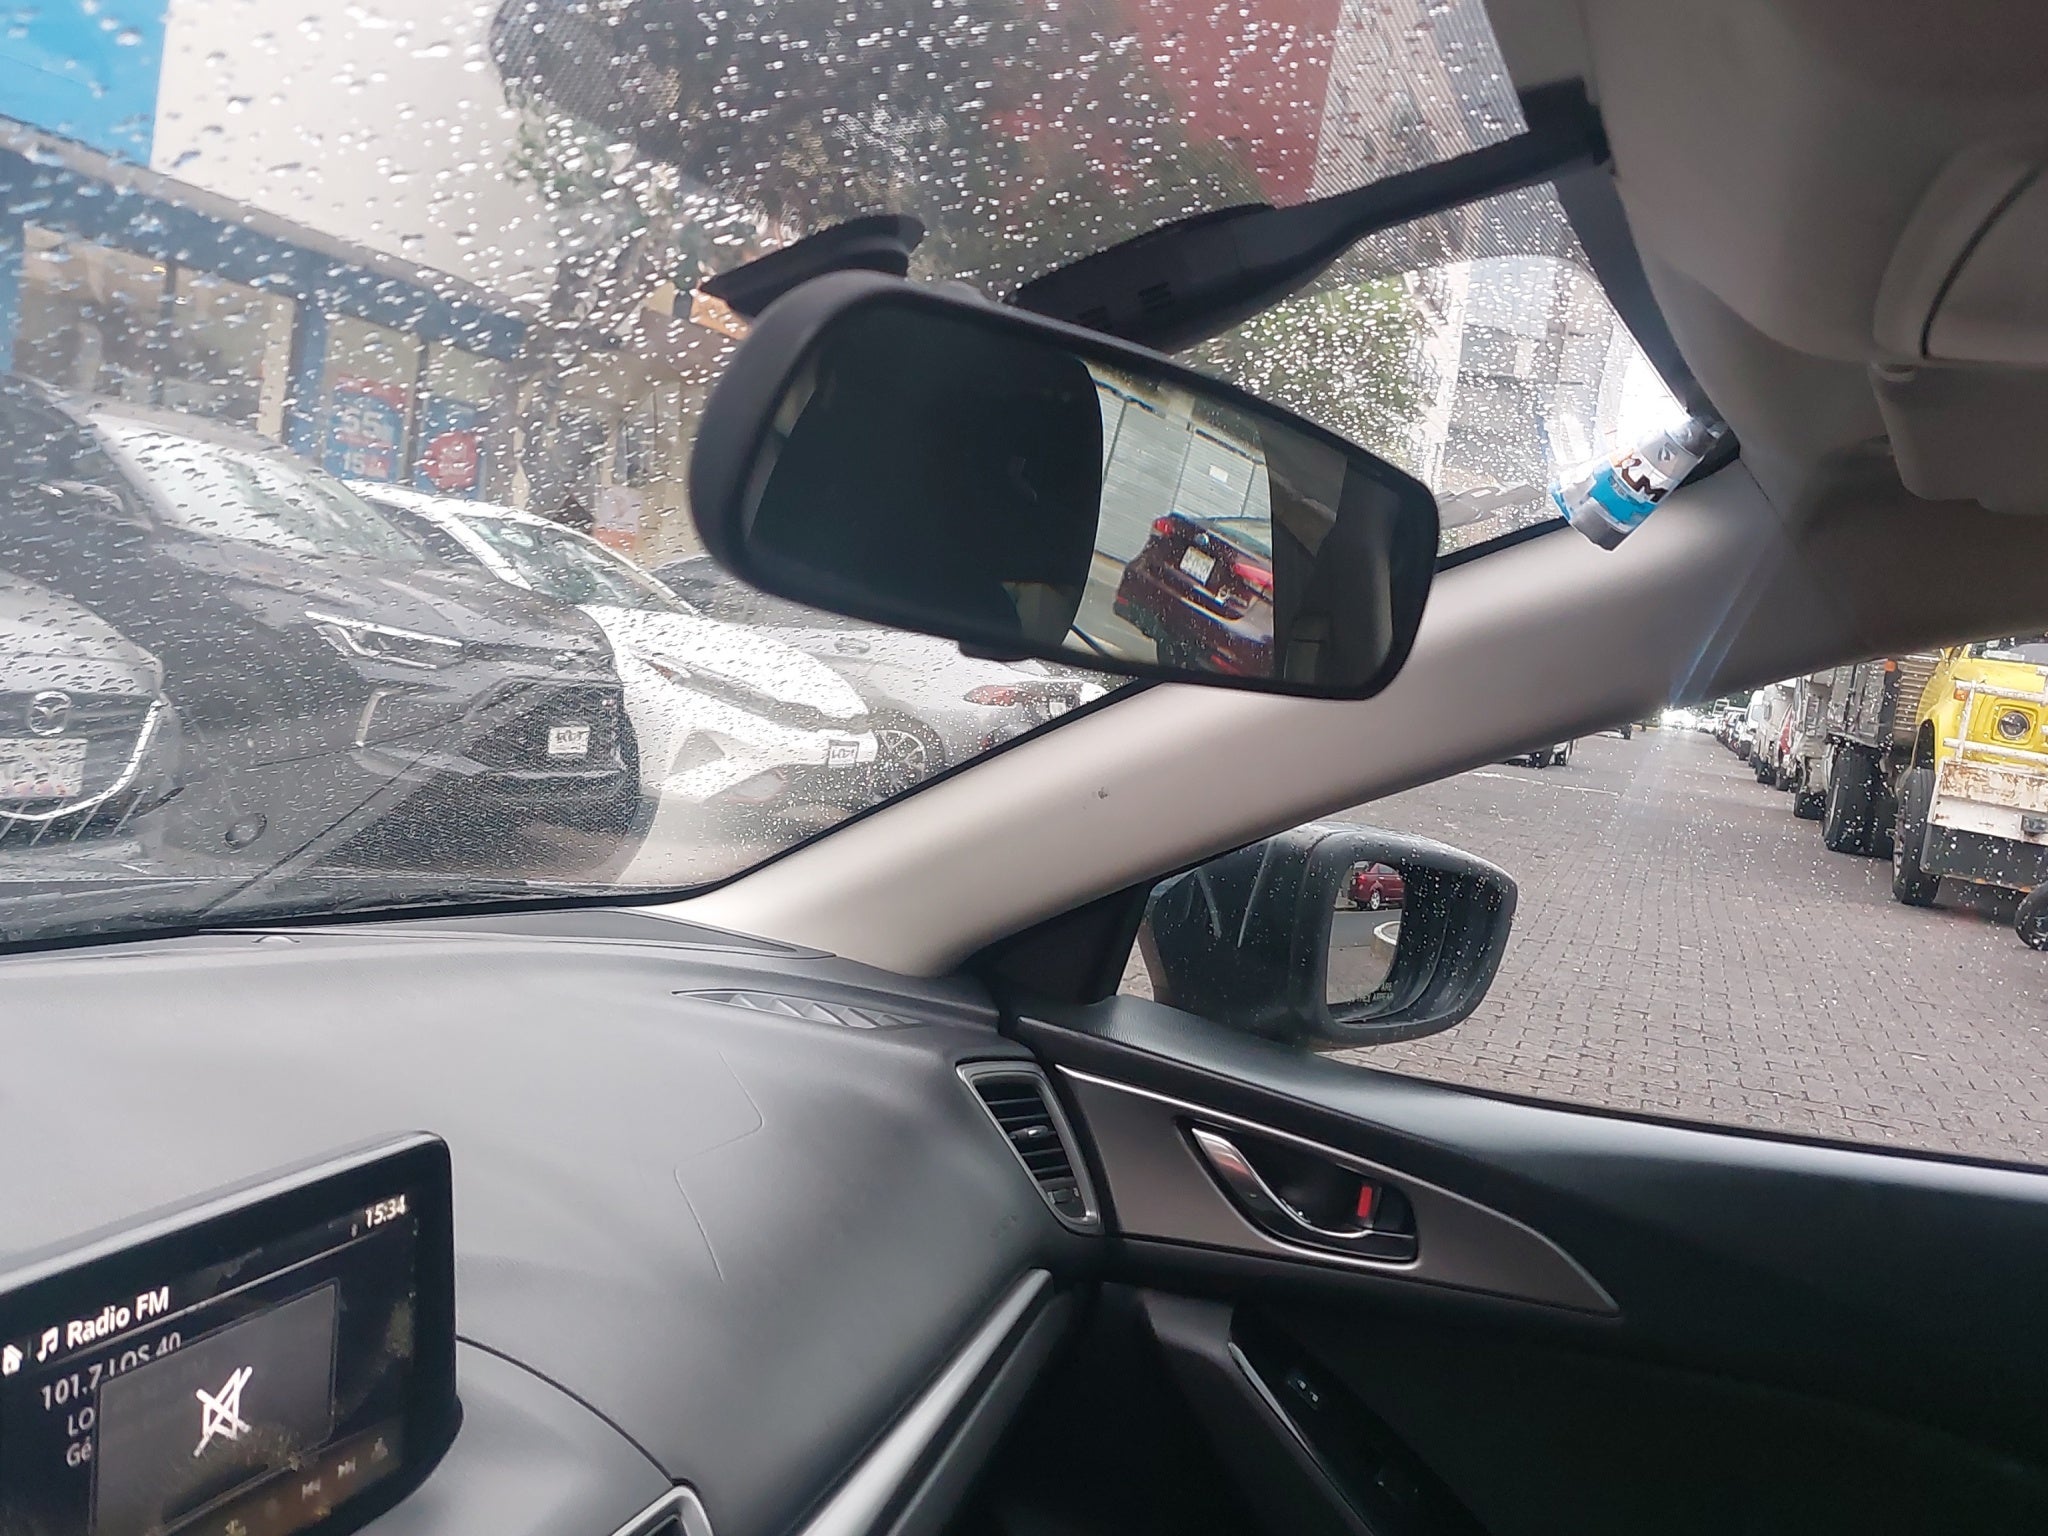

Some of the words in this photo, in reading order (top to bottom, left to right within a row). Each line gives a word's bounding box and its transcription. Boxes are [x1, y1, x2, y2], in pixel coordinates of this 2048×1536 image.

[365, 1193, 406, 1229] 15:34
[66, 1305, 131, 1350] Radio
[136, 1286, 169, 1321] FM
[41, 1362, 103, 1411] 101.7
